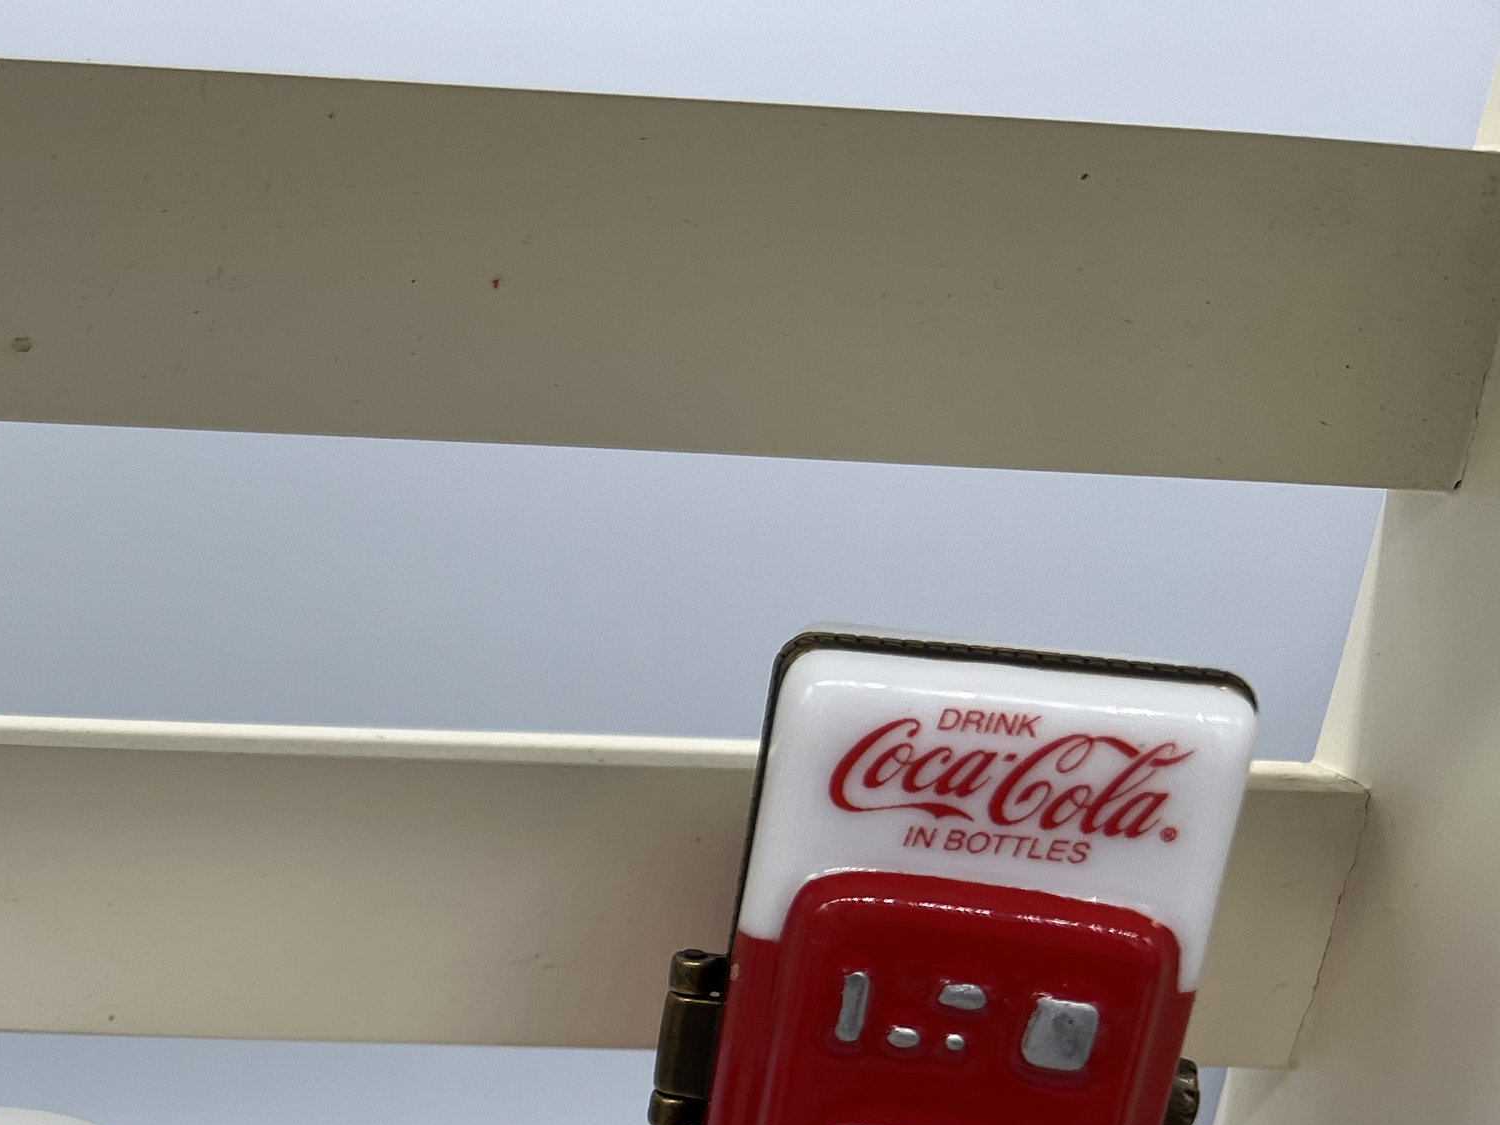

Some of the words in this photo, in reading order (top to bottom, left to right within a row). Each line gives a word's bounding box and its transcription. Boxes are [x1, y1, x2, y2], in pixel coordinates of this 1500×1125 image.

[936, 708, 1041, 738] DRINK
[828, 717, 1196, 840] Coca-Cola
[902, 825, 936, 849] IN
[942, 829, 1092, 865] BOTTLES
